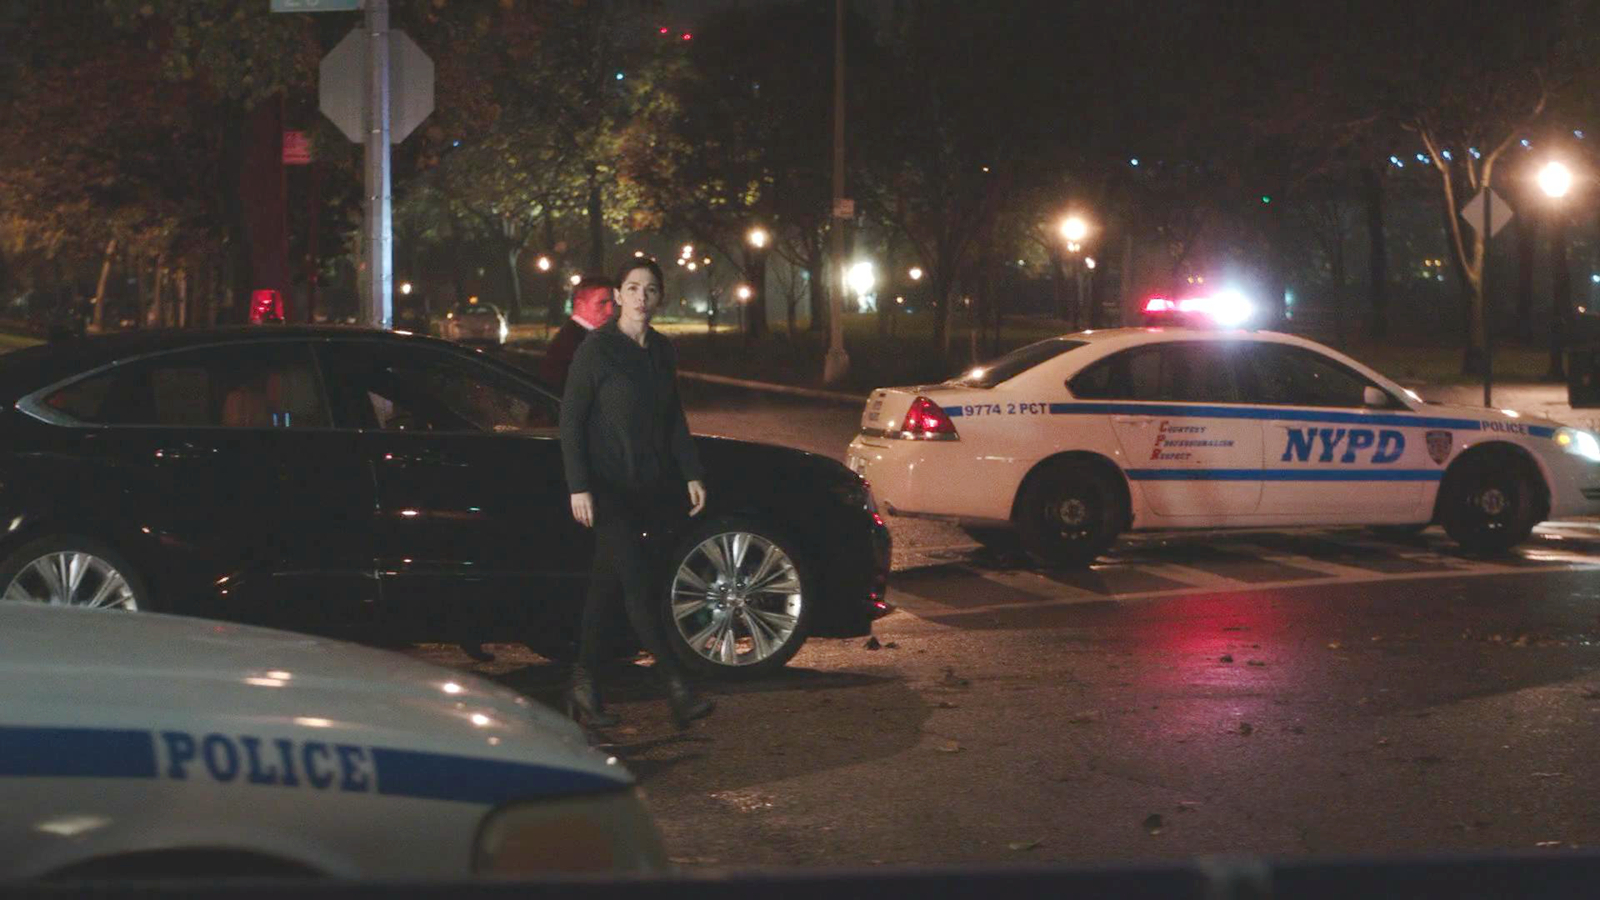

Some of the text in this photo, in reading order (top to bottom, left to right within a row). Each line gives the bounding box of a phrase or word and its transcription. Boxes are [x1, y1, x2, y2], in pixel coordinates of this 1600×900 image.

[964, 403, 1046, 416] 9774 2 PCT
[1481, 420, 1527, 435] POLICE
[1281, 427, 1405, 463] NYPD
[161, 729, 369, 793] POLICE
